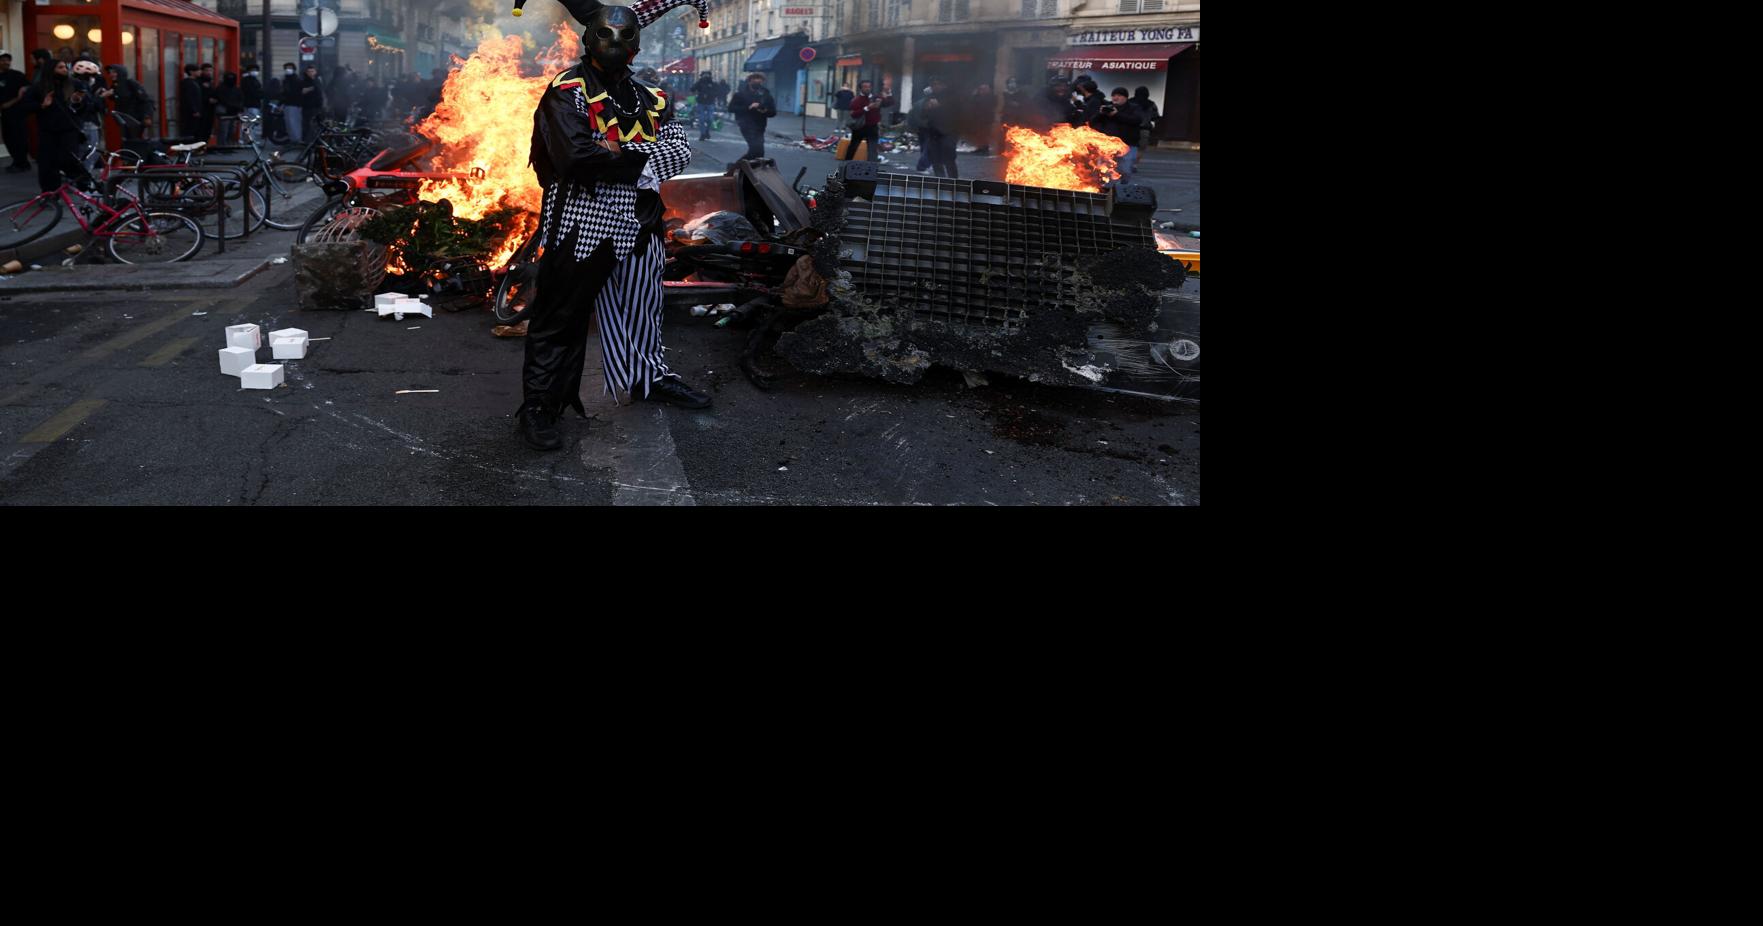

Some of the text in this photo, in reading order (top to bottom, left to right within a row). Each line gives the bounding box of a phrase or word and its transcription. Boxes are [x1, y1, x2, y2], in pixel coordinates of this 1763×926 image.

[1140, 28, 1174, 41] YONG
[1177, 27, 1193, 40] FA
[1101, 61, 1157, 70] ASIATIQUE
